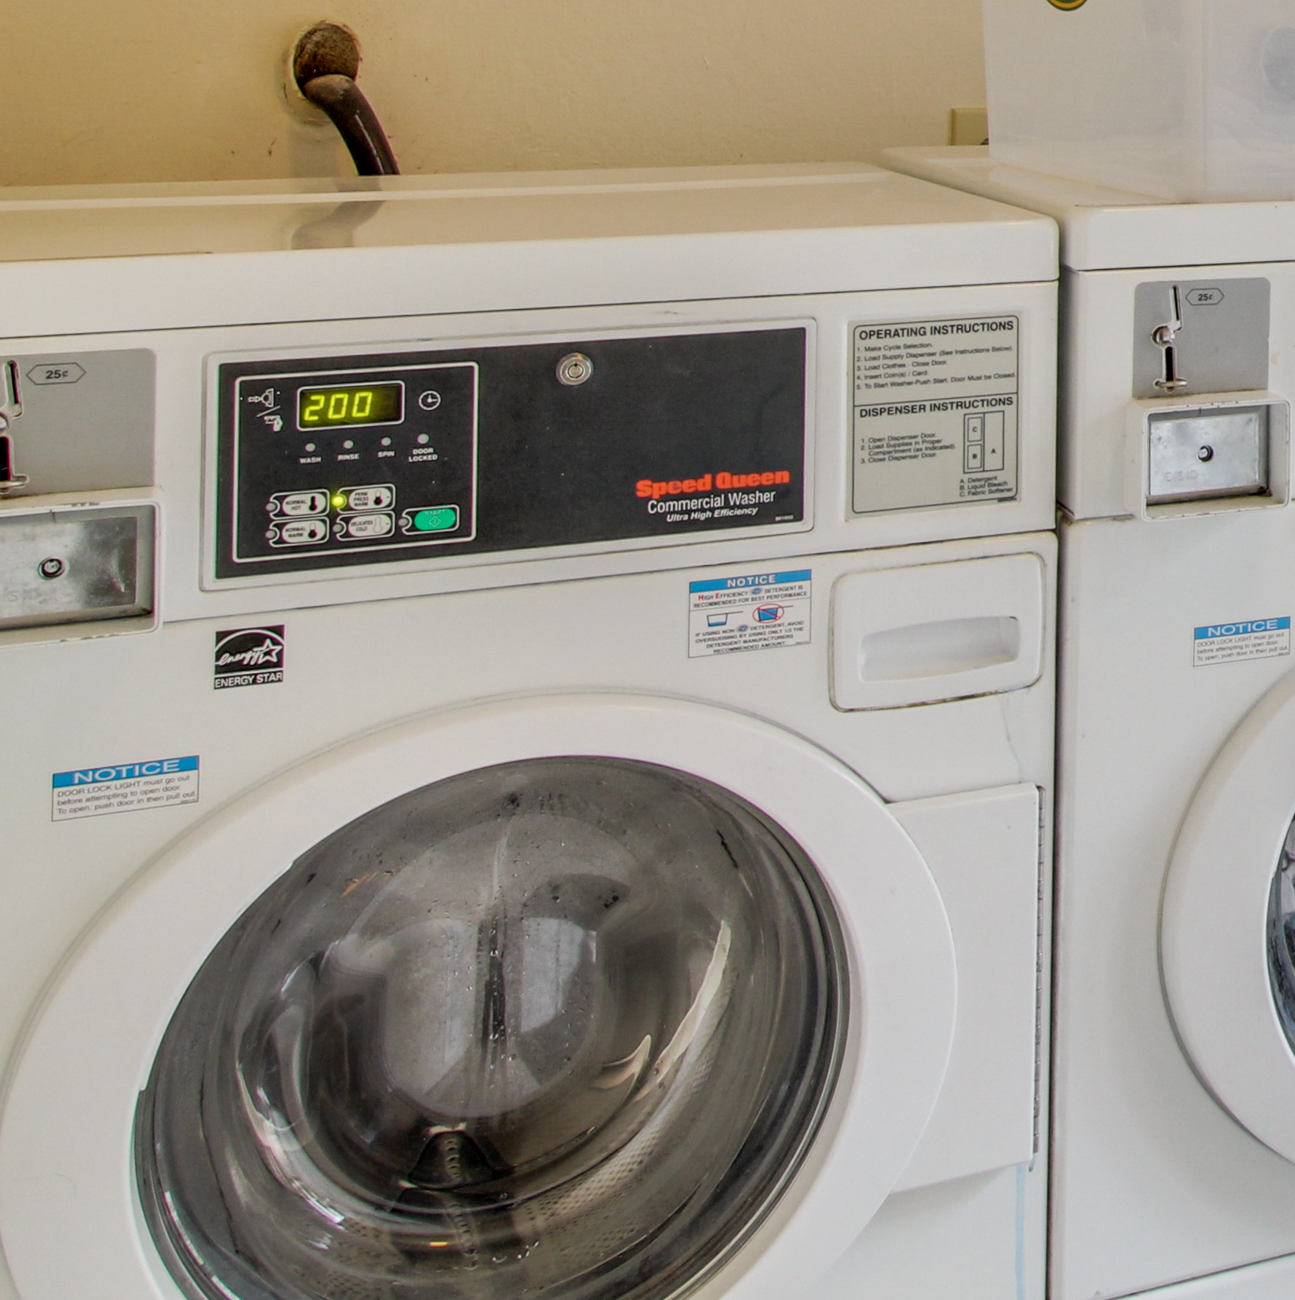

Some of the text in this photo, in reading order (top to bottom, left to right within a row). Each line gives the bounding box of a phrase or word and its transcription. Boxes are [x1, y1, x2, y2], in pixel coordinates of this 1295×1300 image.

[859, 321, 1013, 340] OPERATING INSTRUCTIONS
[304, 392, 373, 421] 200
[860, 397, 1013, 418] DISPENSER INSTRUCTIONS
[300, 456, 321, 464] WASH
[338, 453, 359, 461] RINSE
[409, 454, 437, 462] LOCKED
[636, 470, 790, 499] Speed Queen
[648, 490, 776, 514] Commercial Washer
[667, 507, 758, 522] Ultra High Efficiency
[727, 575, 776, 587] NOTICE
[1208, 620, 1278, 636] NOTICE
[215, 672, 282, 688] ENERGY STAR
[74, 760, 180, 784] NOTICE
[57, 798, 83, 806] before
[86, 792, 128, 802] attempting
[140, 788, 160, 796] open
[58, 788, 84, 798] DOOR
[88, 785, 111, 793] LOCK
[115, 781, 141, 790] LIGHT
[94, 802, 114, 811] push
[166, 793, 180, 802] pull
